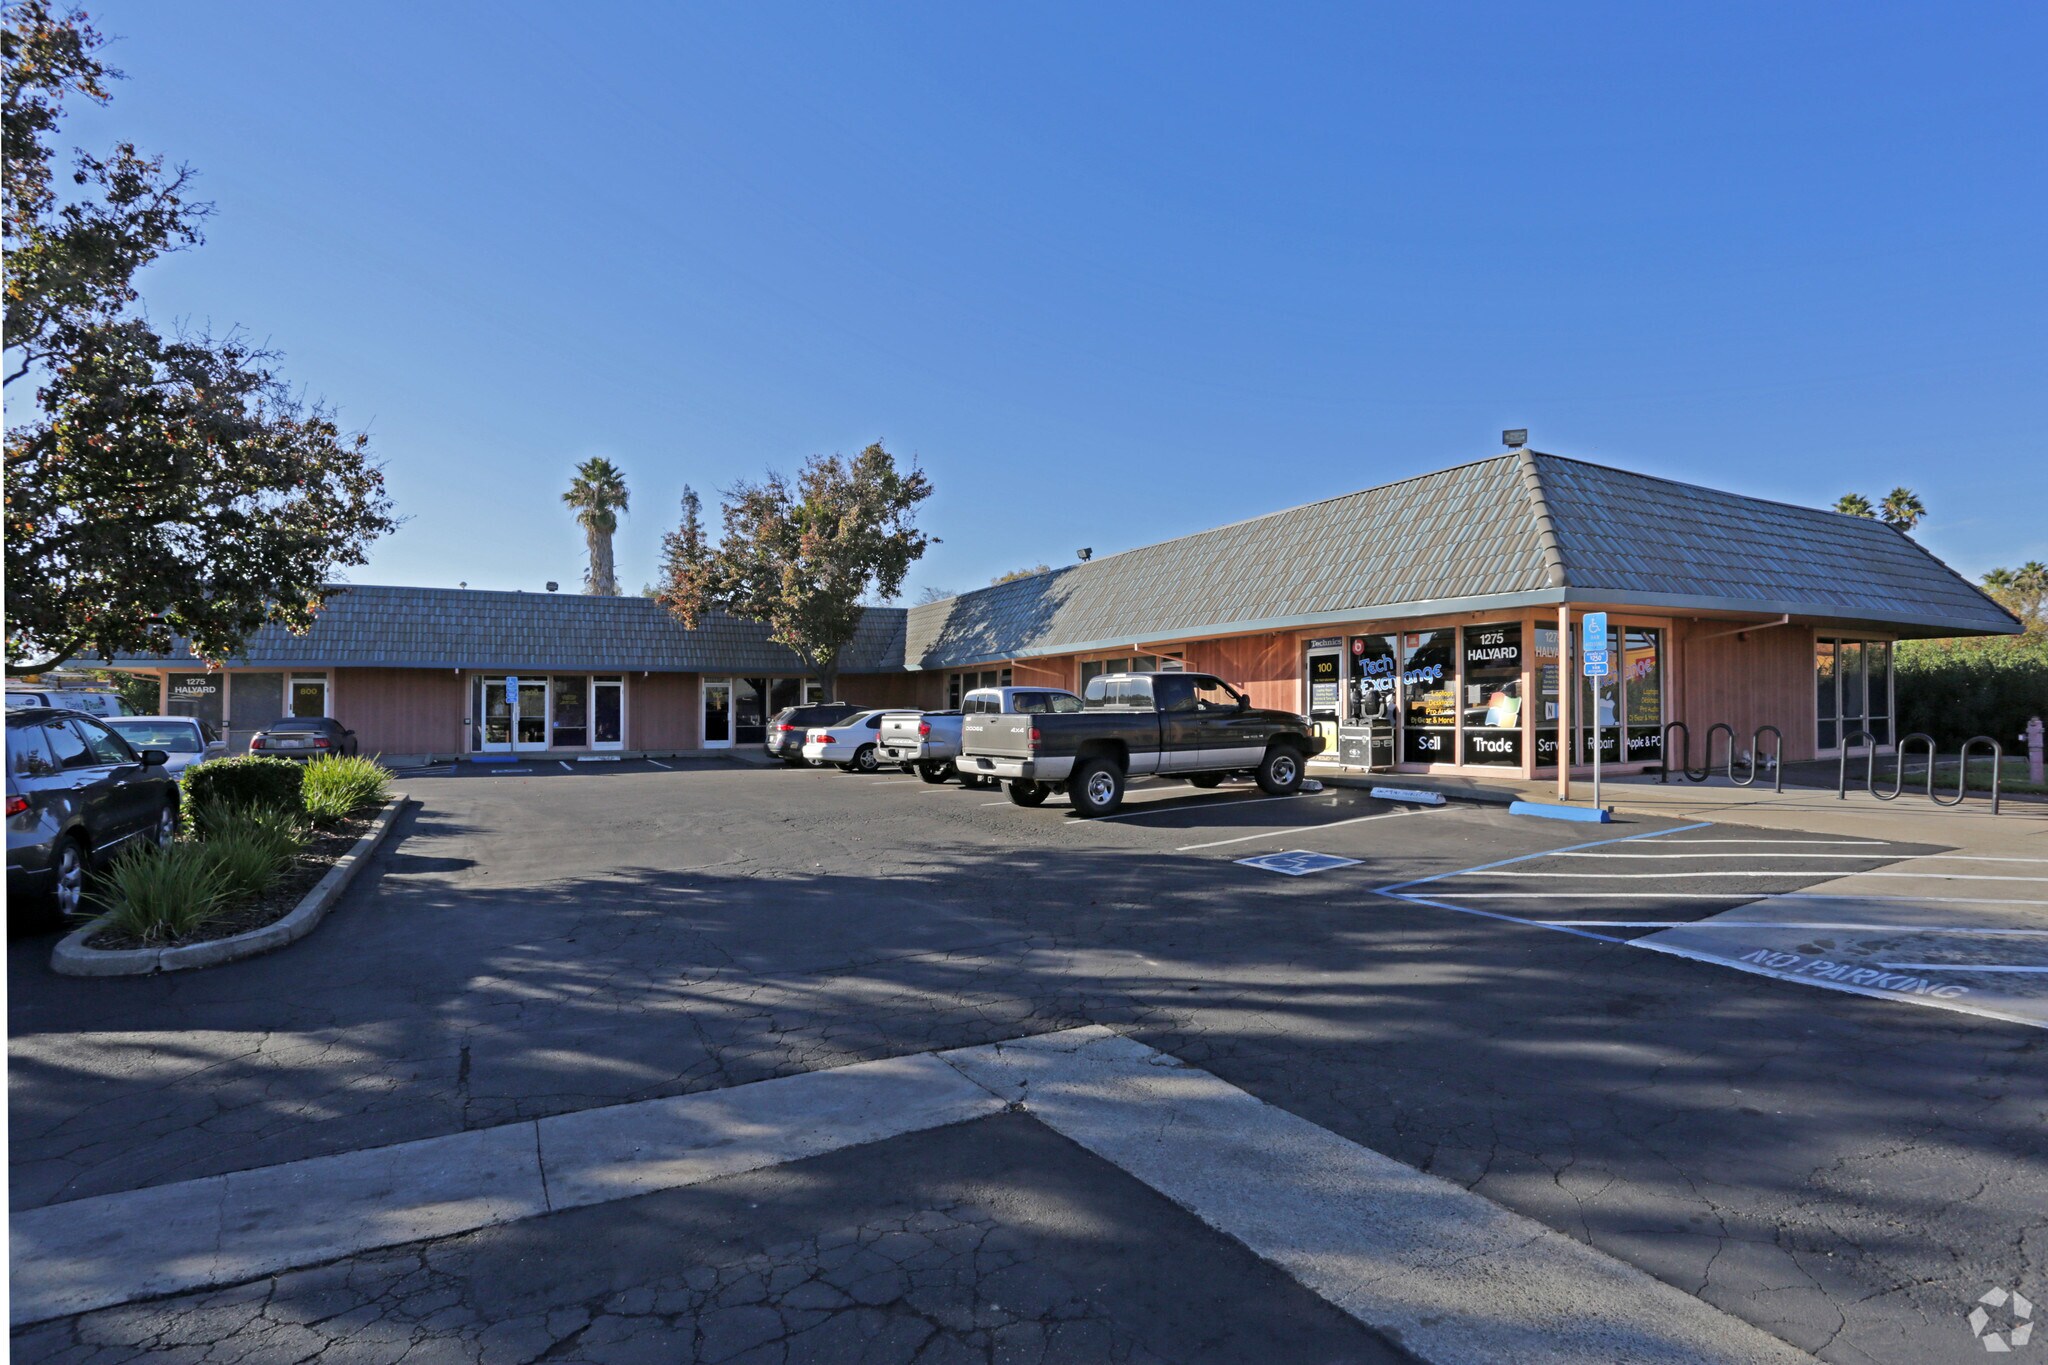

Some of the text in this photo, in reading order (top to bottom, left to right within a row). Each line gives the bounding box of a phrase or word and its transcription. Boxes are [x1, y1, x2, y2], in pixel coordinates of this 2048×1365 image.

[1311, 639, 1342, 648] Technics
[1480, 633, 1504, 645] 1275
[1545, 632, 1559, 643] 127
[1468, 647, 1518, 660] HALYARD
[1536, 646, 1559, 658] HALYA
[1318, 663, 1332, 672] 100
[1359, 653, 1394, 676] Tech
[1361, 663, 1443, 695] Exchange
[1418, 736, 1441, 750] Sell
[1473, 737, 1513, 752] Trade
[1587, 736, 1615, 750] Rpair
[1626, 736, 1662, 750] Apple & PC
[1740, 948, 1970, 998] NO PARKING
